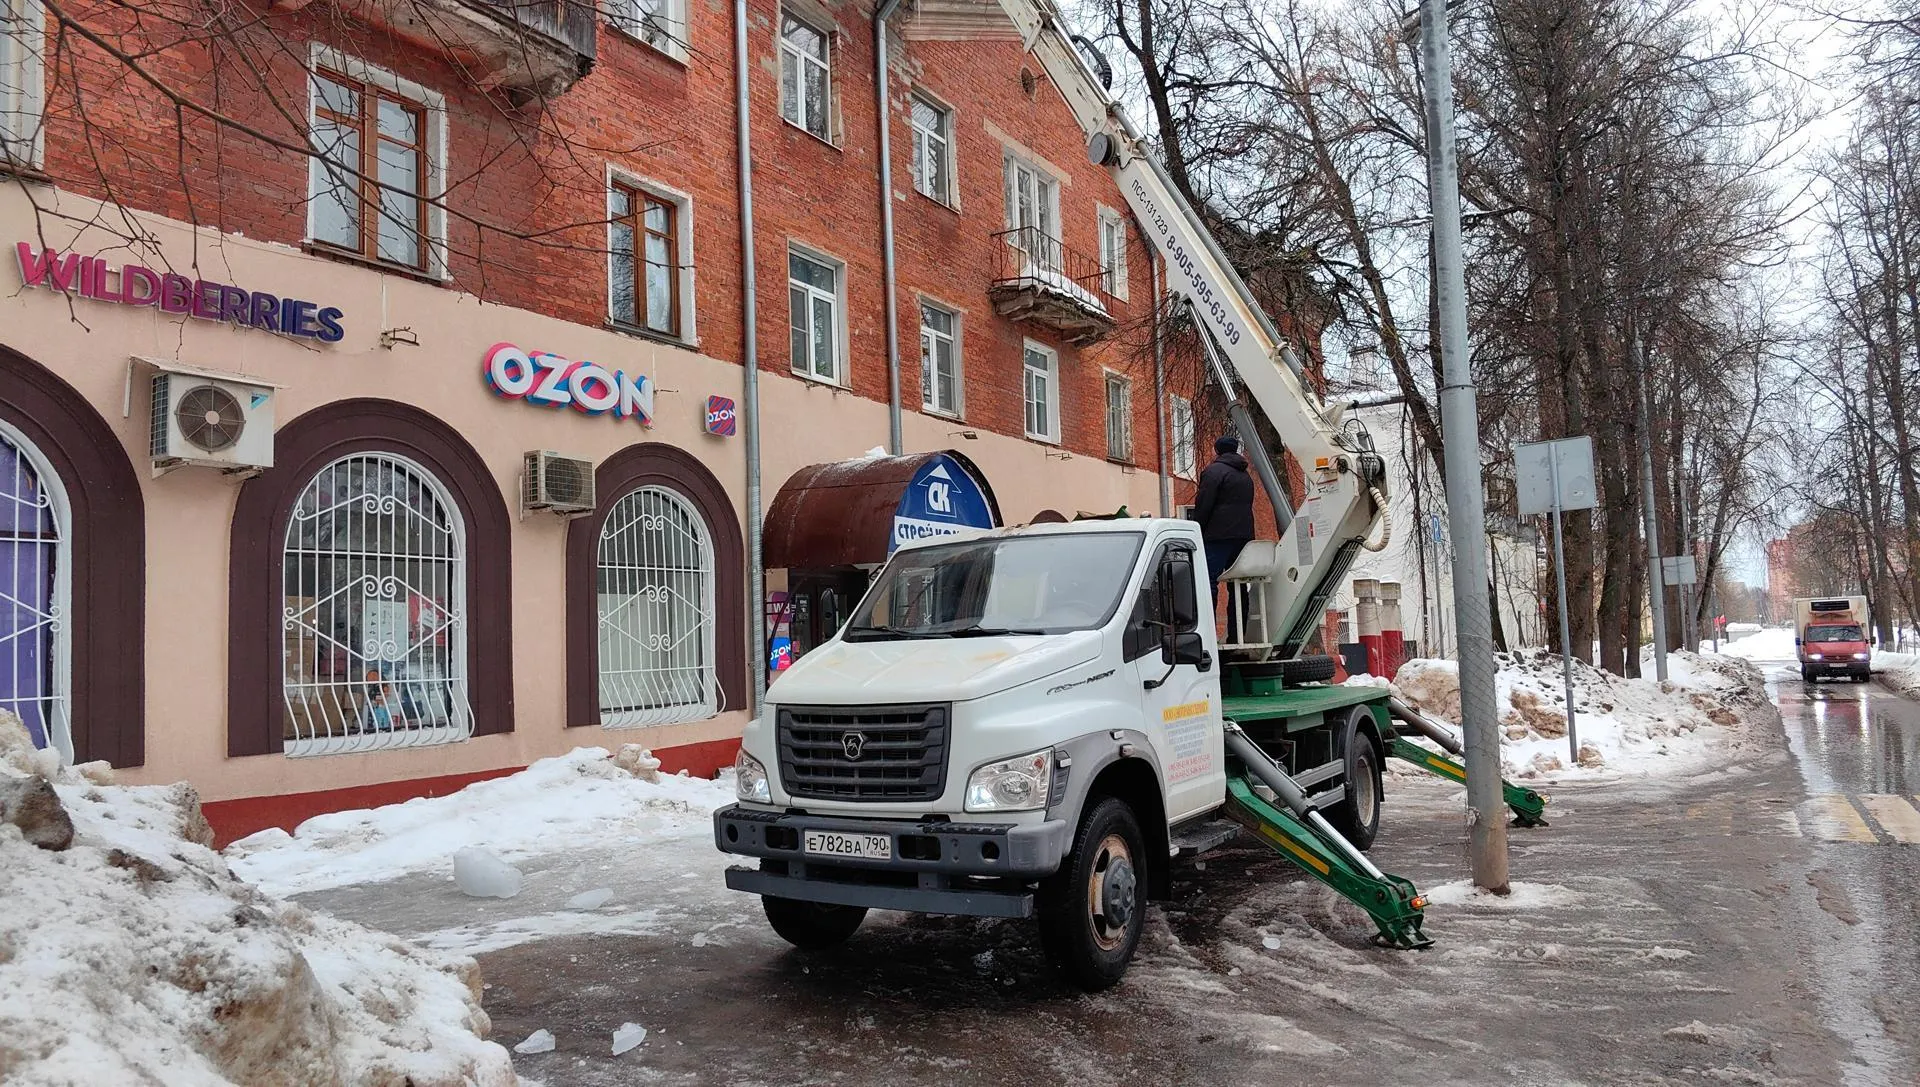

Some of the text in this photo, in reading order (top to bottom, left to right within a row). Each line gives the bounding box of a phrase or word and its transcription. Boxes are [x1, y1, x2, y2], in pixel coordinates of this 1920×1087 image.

[16, 241, 344, 343] WILDBERRIES
[1166, 235, 1240, 346] 8-905-595-63-99
[487, 344, 654, 421] OZON
[708, 408, 736, 423] OZON
[865, 836, 886, 851] 790
